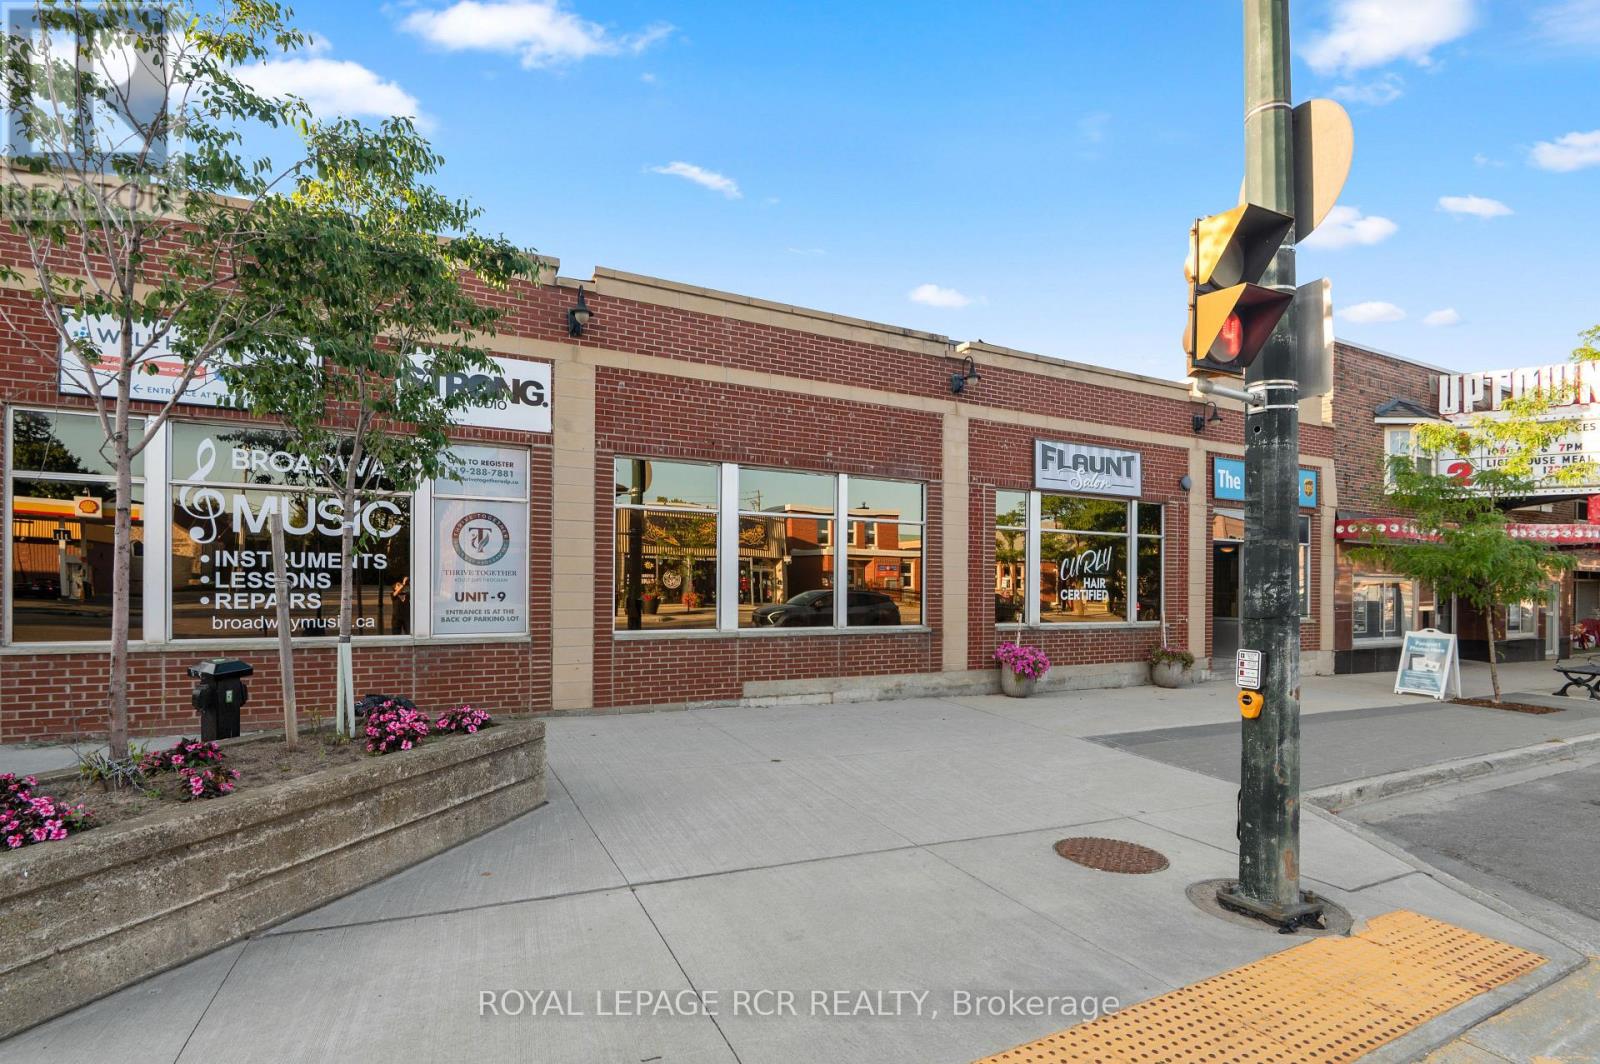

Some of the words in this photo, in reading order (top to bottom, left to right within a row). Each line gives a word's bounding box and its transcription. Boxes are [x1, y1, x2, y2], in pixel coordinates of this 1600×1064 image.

[147, 386, 197, 398] ENTRACE
[1438, 359, 1600, 415] UPTOWN
[1558, 443, 1583, 453] 7PM
[231, 447, 400, 479] BROADWA
[468, 458, 479, 466] TO
[480, 459, 514, 468] REGISTER
[1041, 443, 1135, 478] FLAUNT
[1067, 467, 1112, 491] Salon
[1217, 469, 1241, 490] The
[231, 493, 402, 539] MUSIC
[1060, 546, 1113, 581] CURLY
[214, 571, 332, 590] LESSONS
[444, 569, 475, 577] THRIVE
[475, 569, 517, 577] TOGETHER
[1083, 577, 1106, 589] HAIR
[214, 592, 322, 610] REPARS
[1060, 589, 1109, 601] CERTIFIED
[212, 615, 375, 632] broadwymusi.ca
